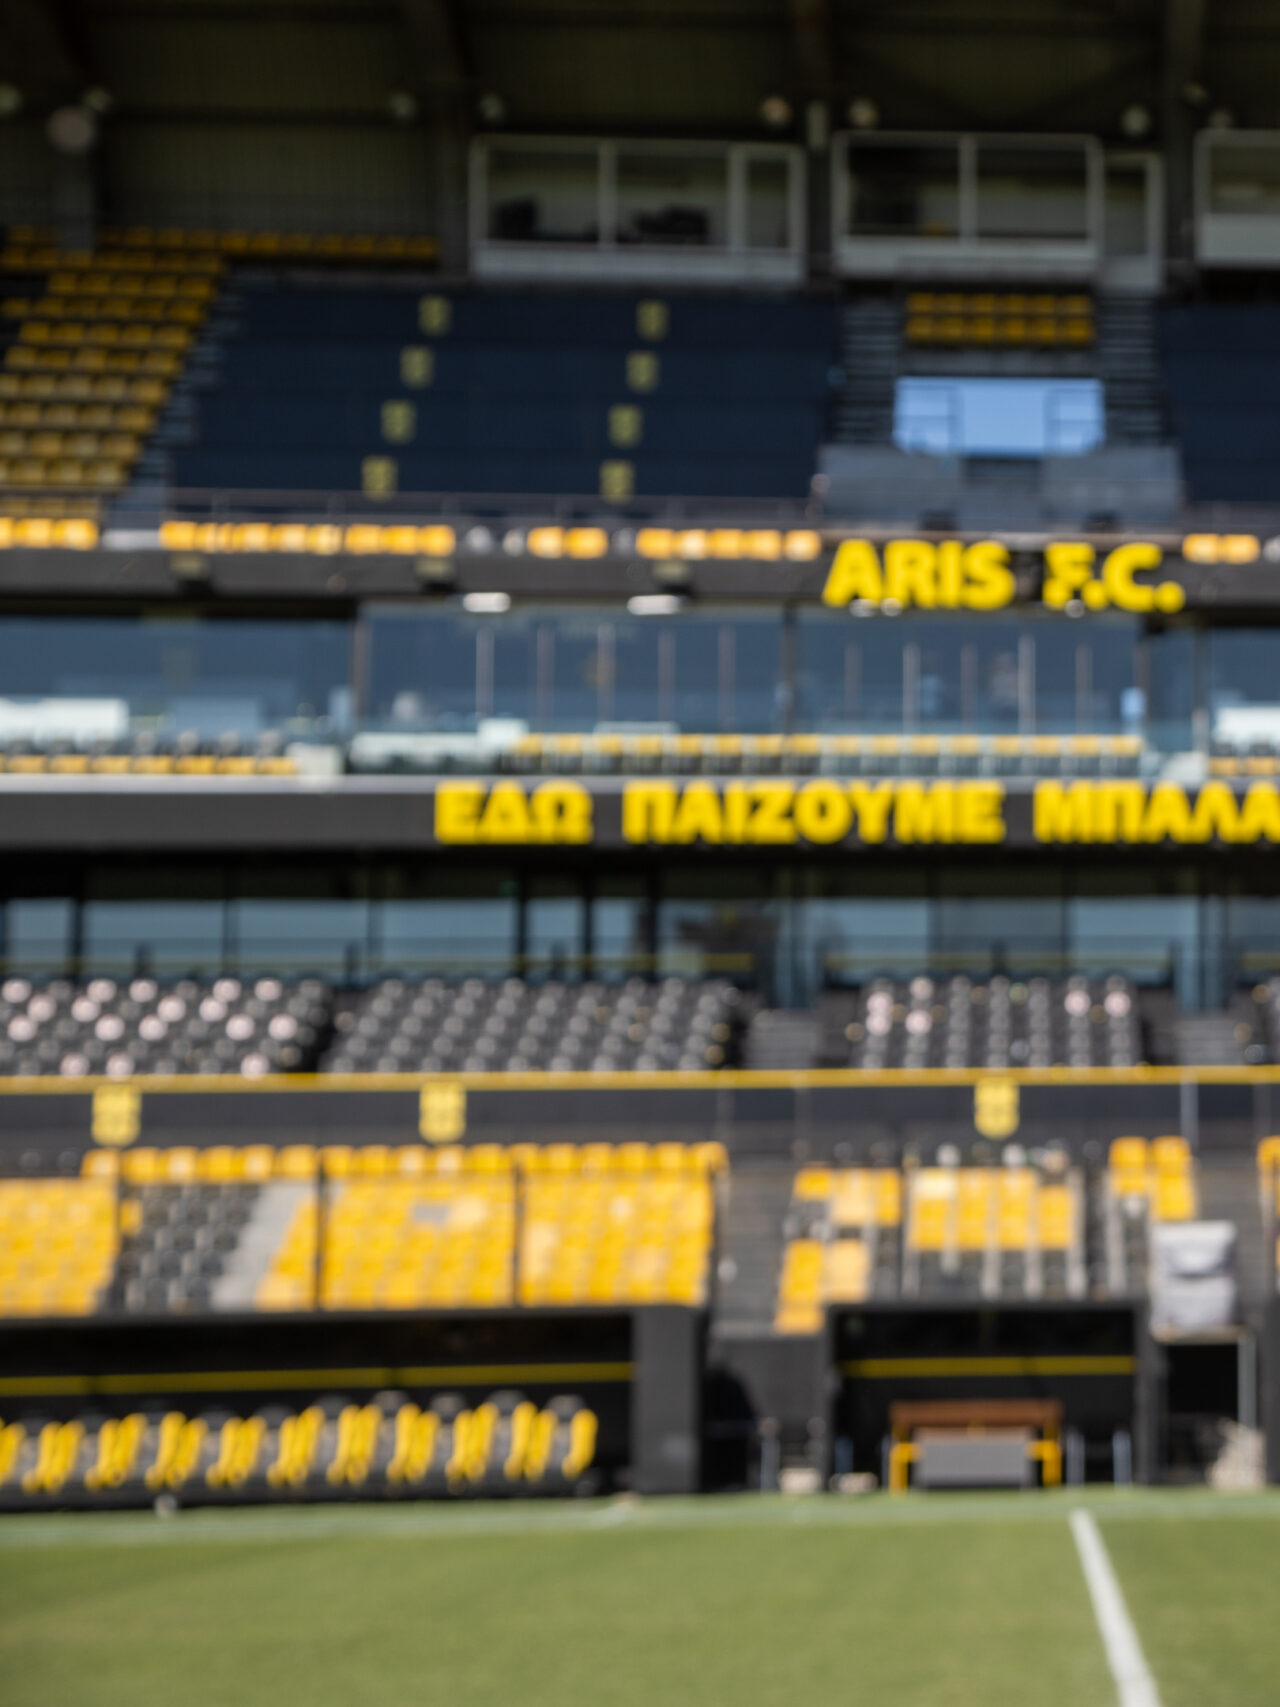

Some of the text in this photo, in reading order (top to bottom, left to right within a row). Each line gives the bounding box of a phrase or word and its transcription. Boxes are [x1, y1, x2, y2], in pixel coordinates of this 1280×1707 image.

[823, 538, 1187, 613] ARIS F.C.
[434, 780, 593, 844] ΕΔΩ
[622, 780, 1005, 844] ΠΑΙΖΟΥΜΕ
